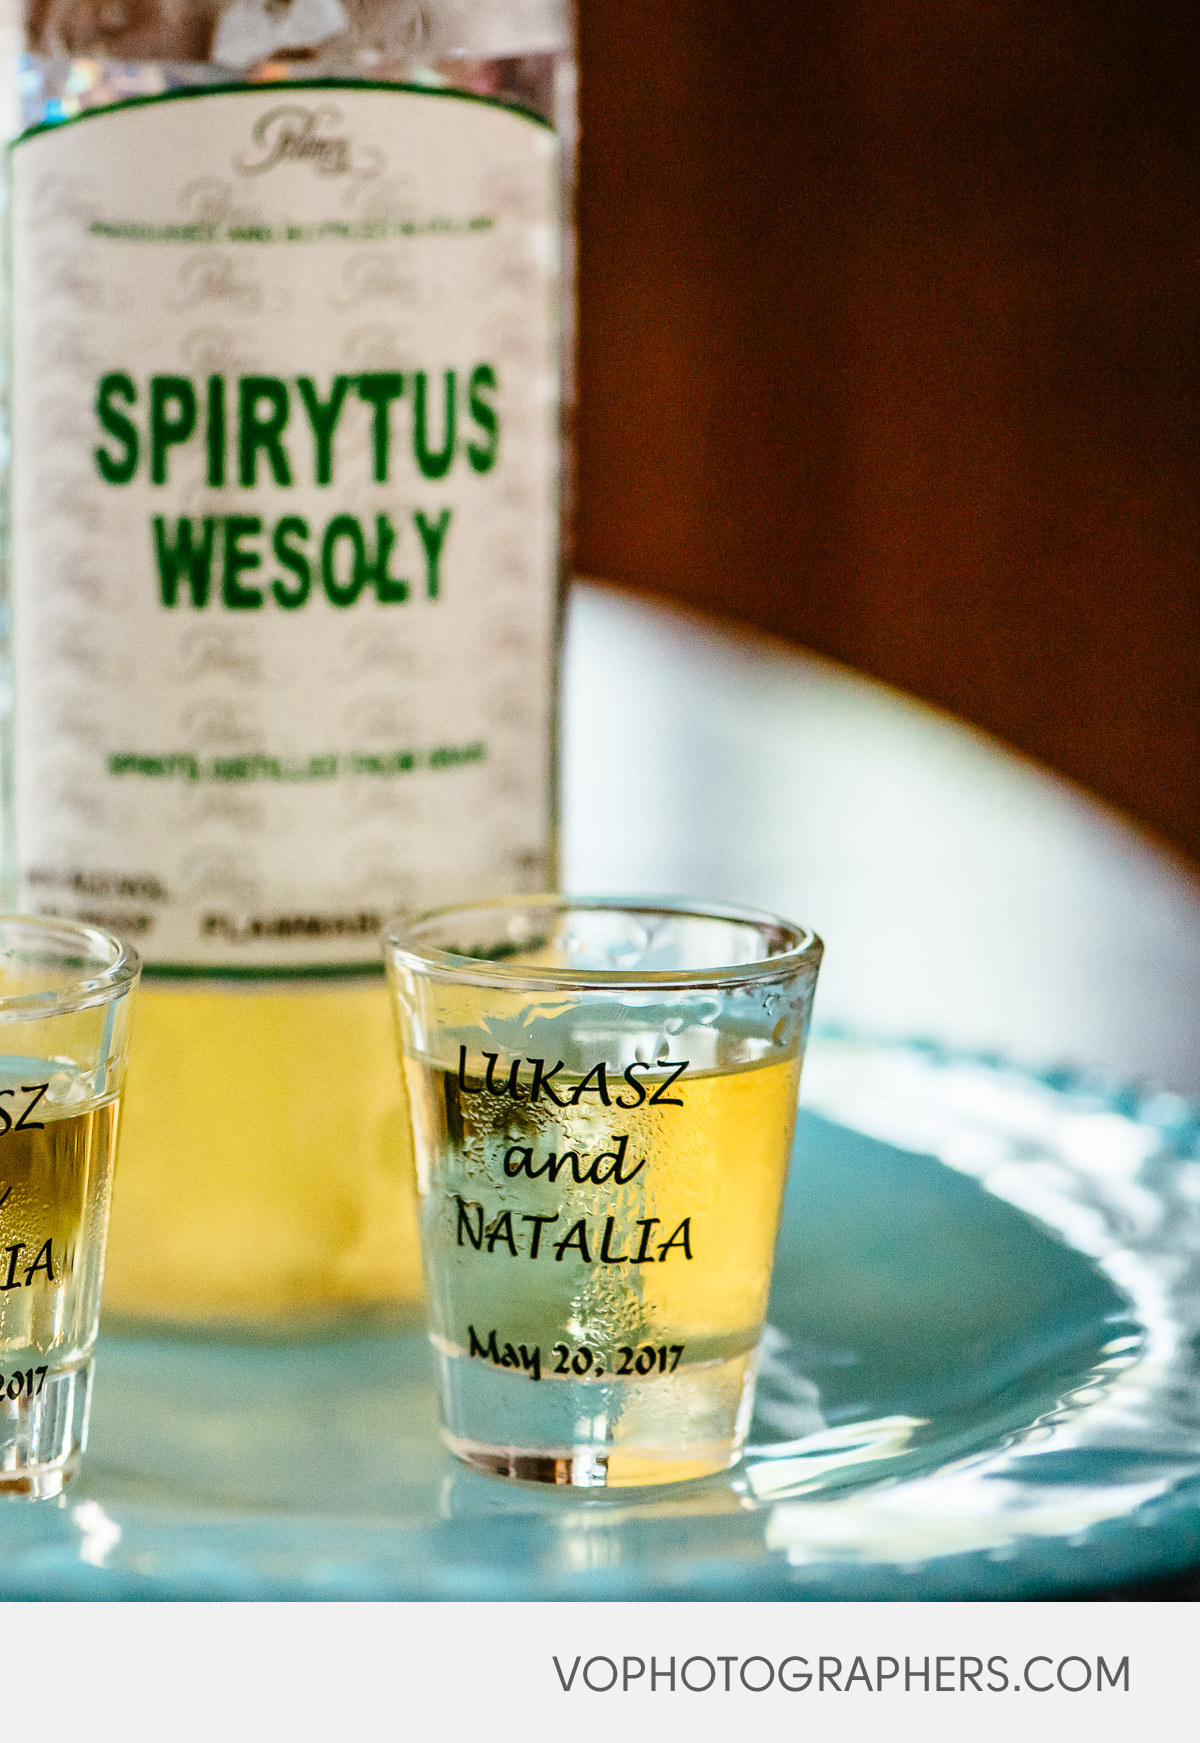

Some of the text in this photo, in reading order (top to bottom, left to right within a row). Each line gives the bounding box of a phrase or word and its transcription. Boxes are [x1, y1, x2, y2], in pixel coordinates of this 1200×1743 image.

[95, 364, 498, 486] SPIRYTUS
[152, 507, 452, 610] WESOŁY
[457, 1044, 690, 1109] LUKASZ
[503, 1135, 646, 1186] and
[455, 1194, 693, 1265] NATALIA
[467, 1325, 685, 1381] May 20, 2017
